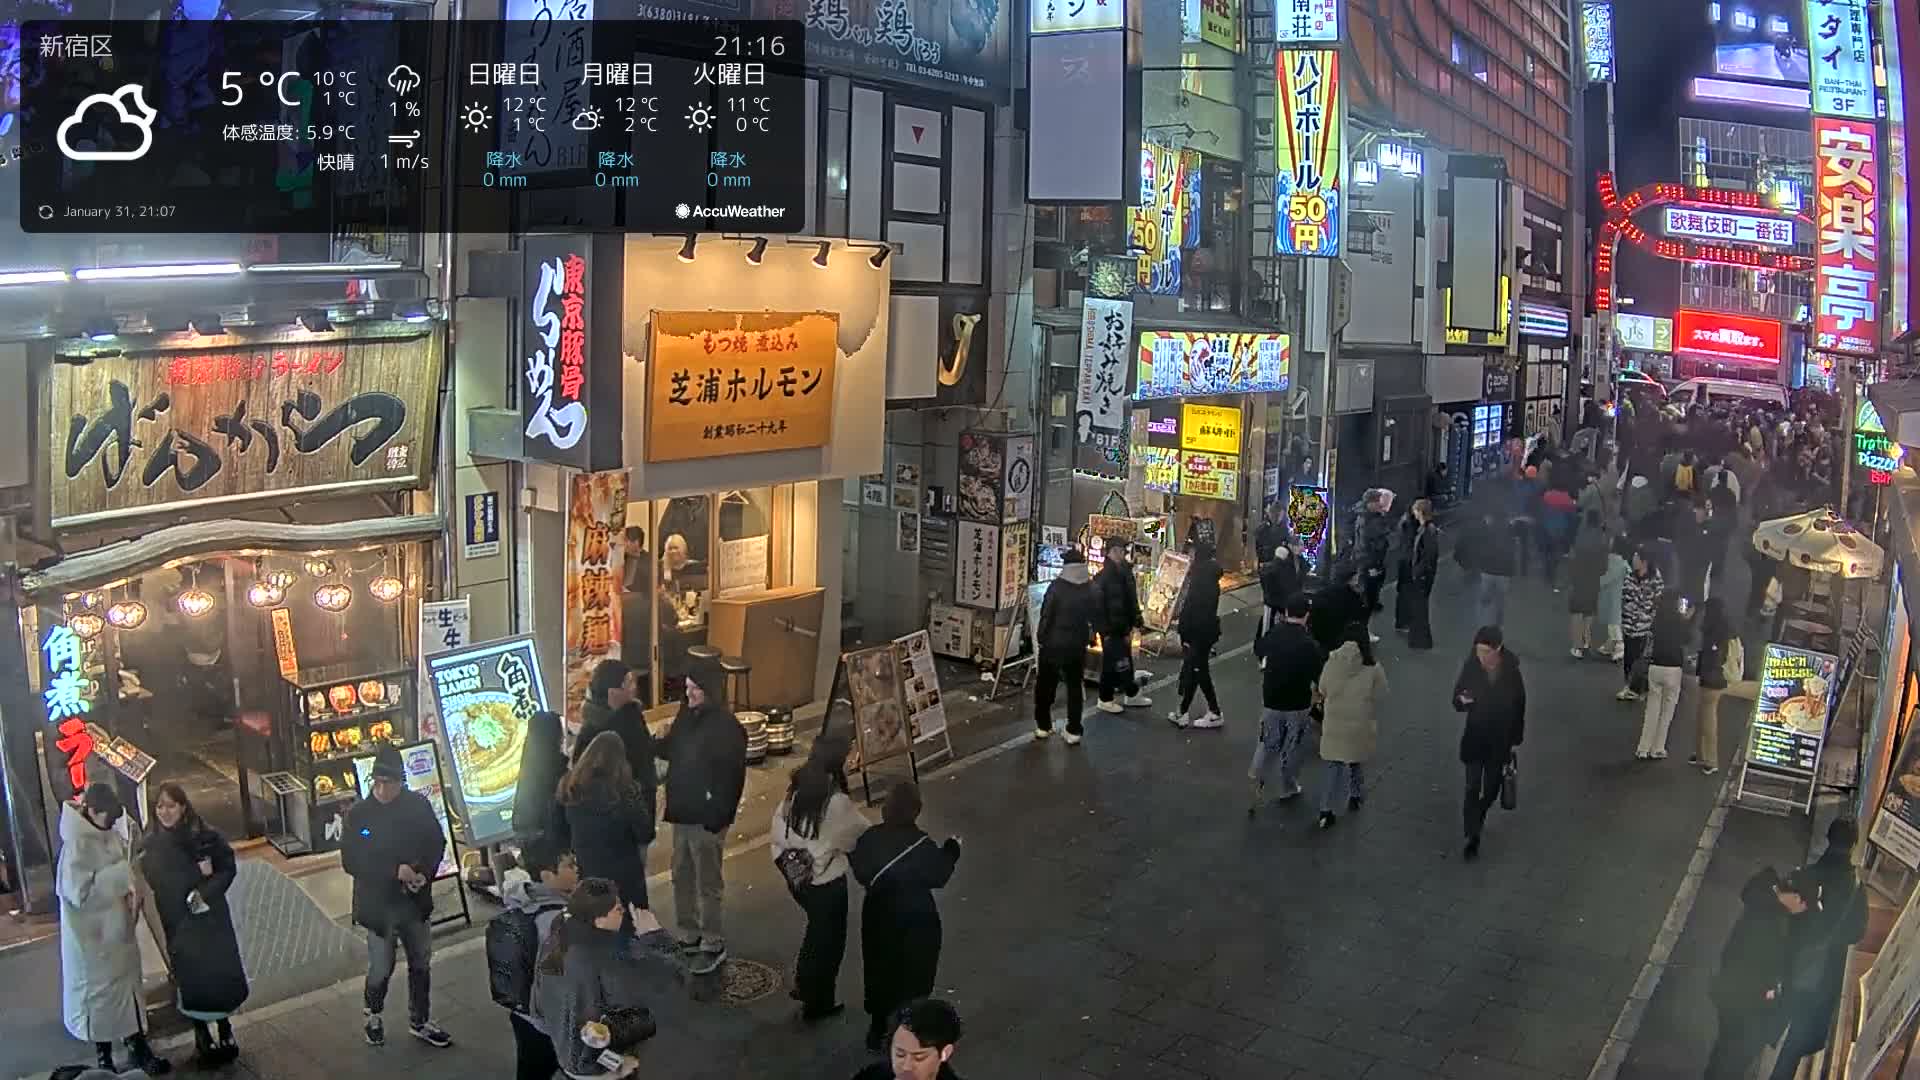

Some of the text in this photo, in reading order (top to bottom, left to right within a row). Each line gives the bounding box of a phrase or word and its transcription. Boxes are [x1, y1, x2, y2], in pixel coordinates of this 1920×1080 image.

[905, 62, 917, 73] TEL
[1588, 63, 1610, 81] 7F
[1832, 97, 1856, 112] 3F
[1294, 53, 1322, 192] ハイボール
[1160, 152, 1176, 289] ハイボール
[1288, 194, 1328, 252] 50円
[1669, 211, 1790, 242] 歌舞伎町一番街
[1818, 127, 1876, 331] 安楽亭
[560, 253, 586, 402] 東京豚骨
[702, 331, 800, 355] もつ焼 煮込み
[1094, 309, 1127, 416] お好み焼き
[668, 365, 824, 406] 芝浦ホルモン
[64, 380, 407, 493] ばんから
[702, 421, 789, 441] 創業昭和二十九年
[1095, 433, 1120, 447] B1F
[1854, 433, 1898, 453] Tratt
[1870, 468, 1892, 485] Bar
[971, 527, 984, 602] 芝浦ホルモン
[438, 607, 454, 628] 生
[434, 663, 480, 684] TOKYO
[1768, 667, 1814, 679] CHEESE
[438, 676, 482, 698] RAMEN
[498, 654, 539, 720] 角煮
[42, 624, 96, 798] 角煮ラー
